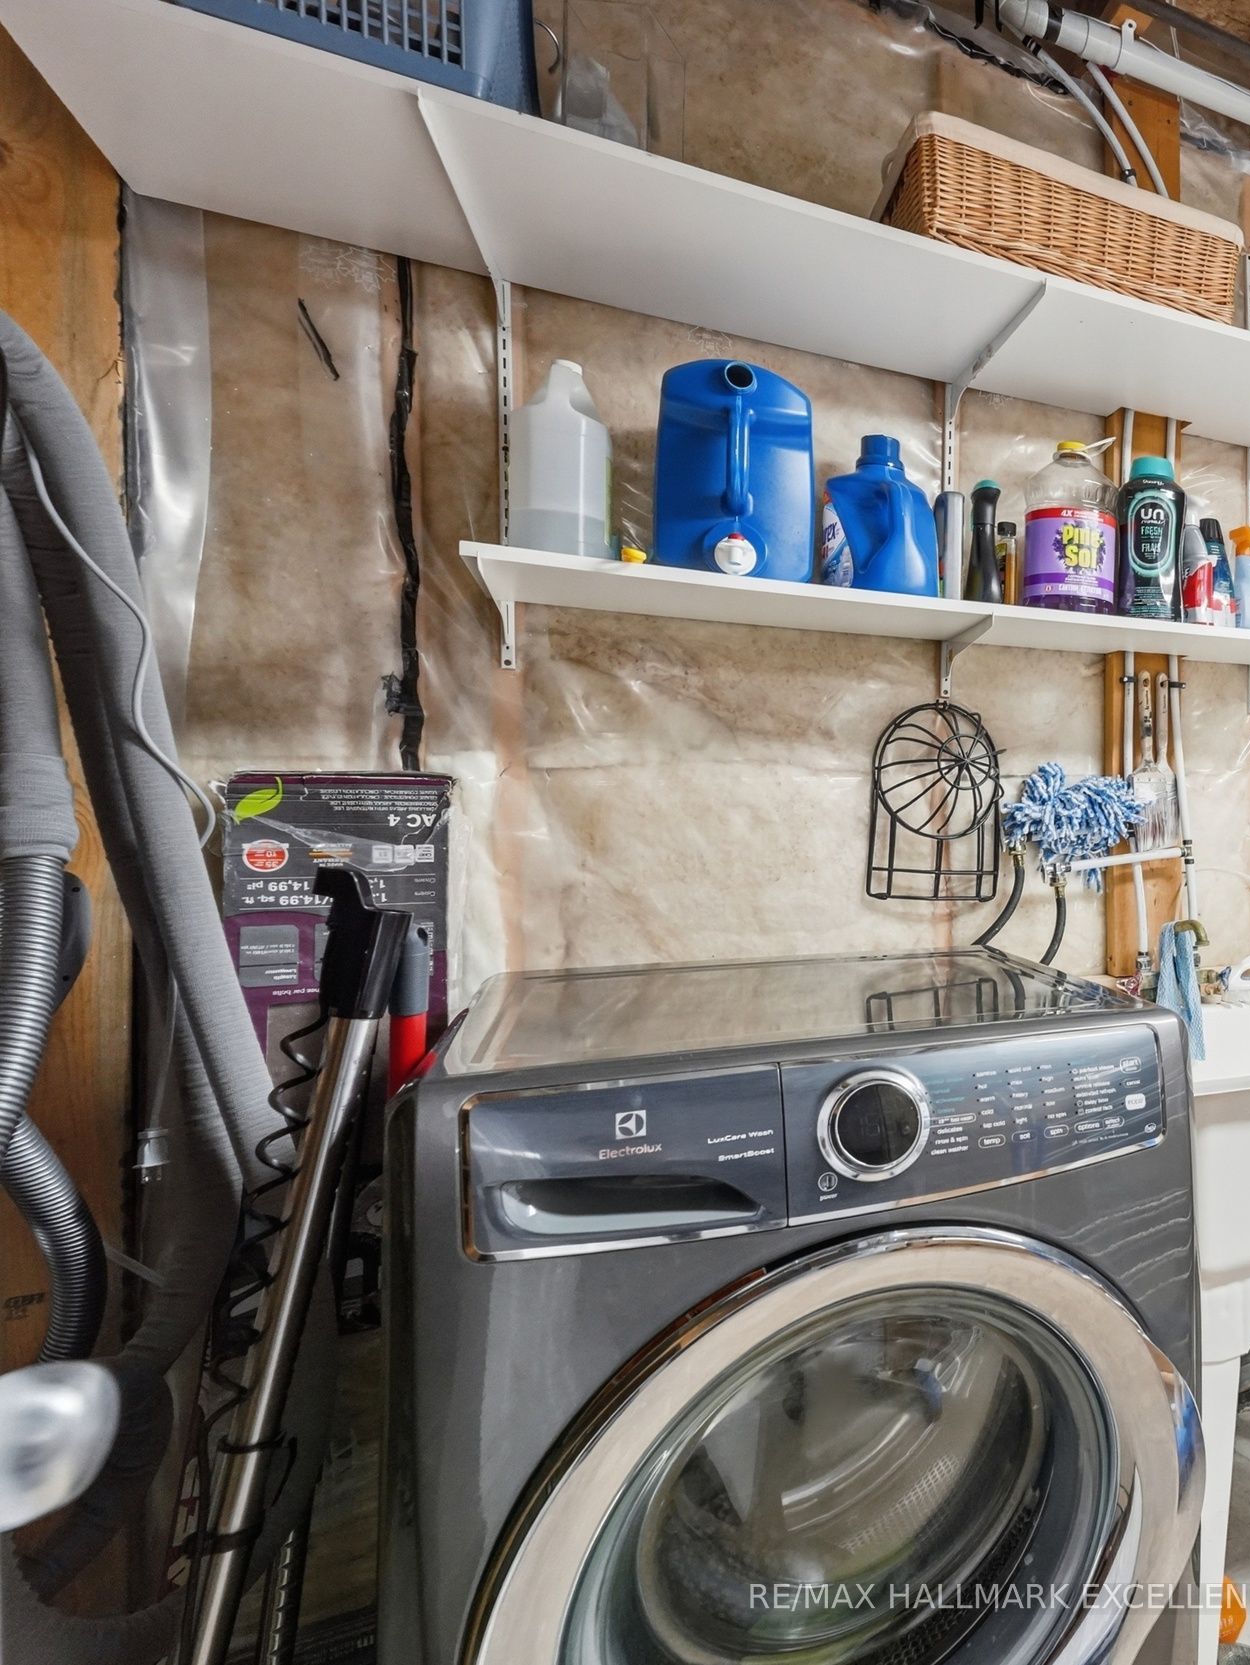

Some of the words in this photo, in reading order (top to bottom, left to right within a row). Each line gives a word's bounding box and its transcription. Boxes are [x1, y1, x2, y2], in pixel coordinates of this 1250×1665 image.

[1062, 525, 1101, 549] Pine
[1065, 545, 1098, 569] Sol
[387, 814, 400, 827] 4
[407, 813, 437, 827] AC
[268, 881, 310, 891] 14,99
[1077, 1122, 1100, 1131] options
[707, 1132, 747, 1145] LuxCare
[749, 1128, 774, 1138] Wash
[598, 1141, 662, 1160] Electrolux
[718, 1147, 775, 1162] SmartBoost
